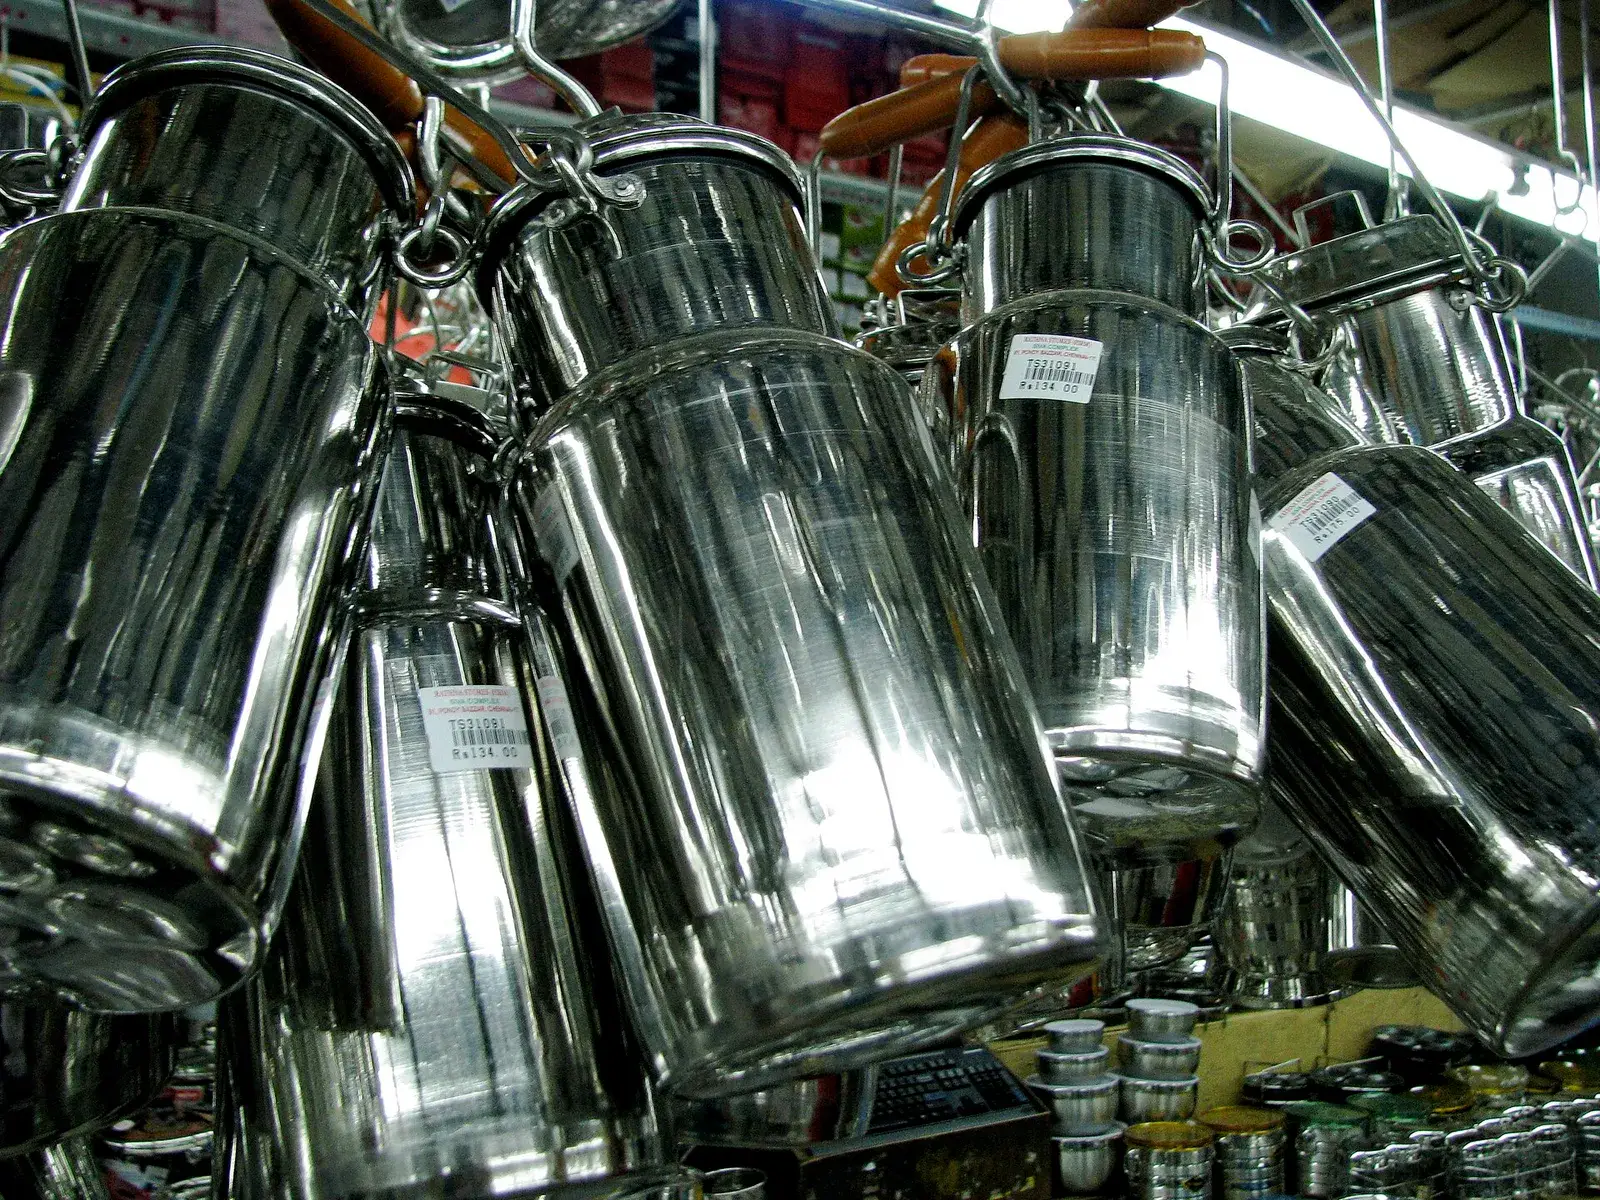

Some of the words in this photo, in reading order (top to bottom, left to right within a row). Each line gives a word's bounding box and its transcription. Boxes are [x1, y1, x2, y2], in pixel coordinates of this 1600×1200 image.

[1026, 358, 1077, 371] TS31091
[1299, 495, 1340, 528] TS31090
[448, 717, 506, 731] TS31091
